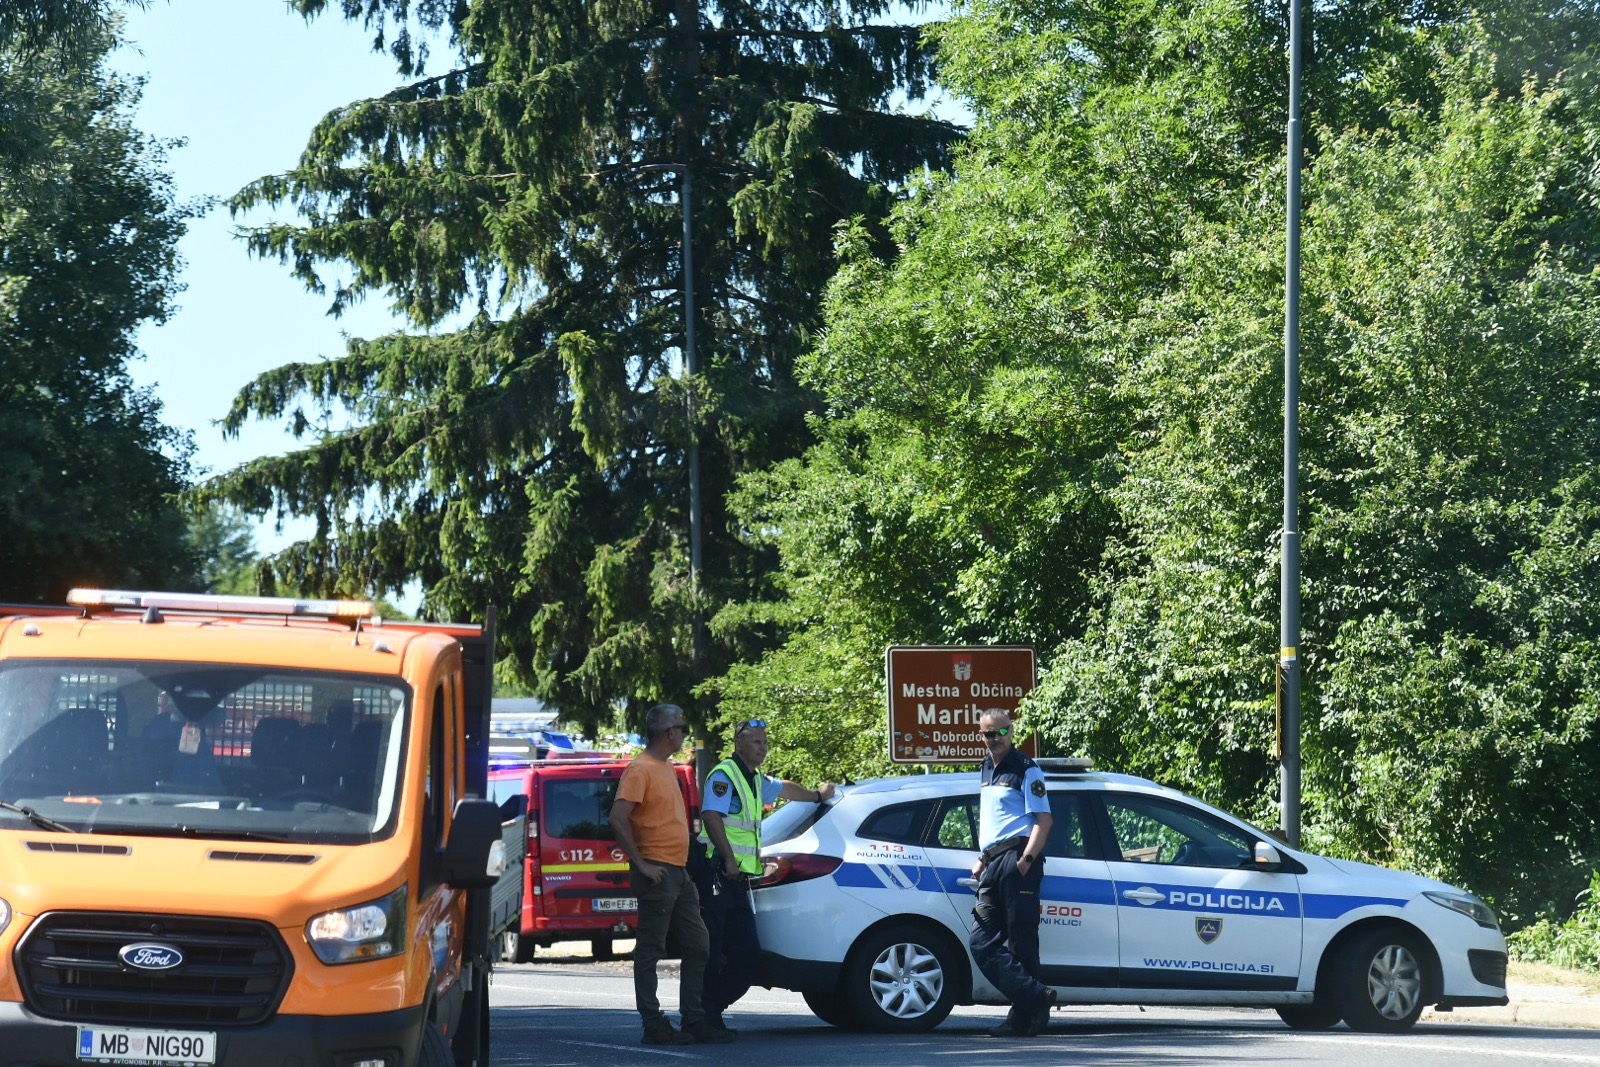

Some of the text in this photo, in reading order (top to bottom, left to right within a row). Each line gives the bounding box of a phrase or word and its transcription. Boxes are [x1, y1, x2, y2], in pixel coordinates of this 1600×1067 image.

[903, 682, 1023, 698] Mestna Občina
[917, 703, 1009, 725] Marib
[933, 730, 982, 743] Dobrodo
[938, 745, 991, 757] Welcome
[869, 844, 905, 852] 113
[570, 849, 594, 861] 112
[856, 851, 922, 861] NUJNI KLICI
[600, 899, 638, 909] MB EF-81
[1169, 891, 1285, 911] POLICIJA
[1053, 918, 1082, 927] KLICI
[133, 948, 171, 966] Ford
[1143, 958, 1274, 973] WWW.POLICIJA.SI
[81, 1046, 91, 1054] SLO
[100, 1033, 204, 1058] MB NIG90
